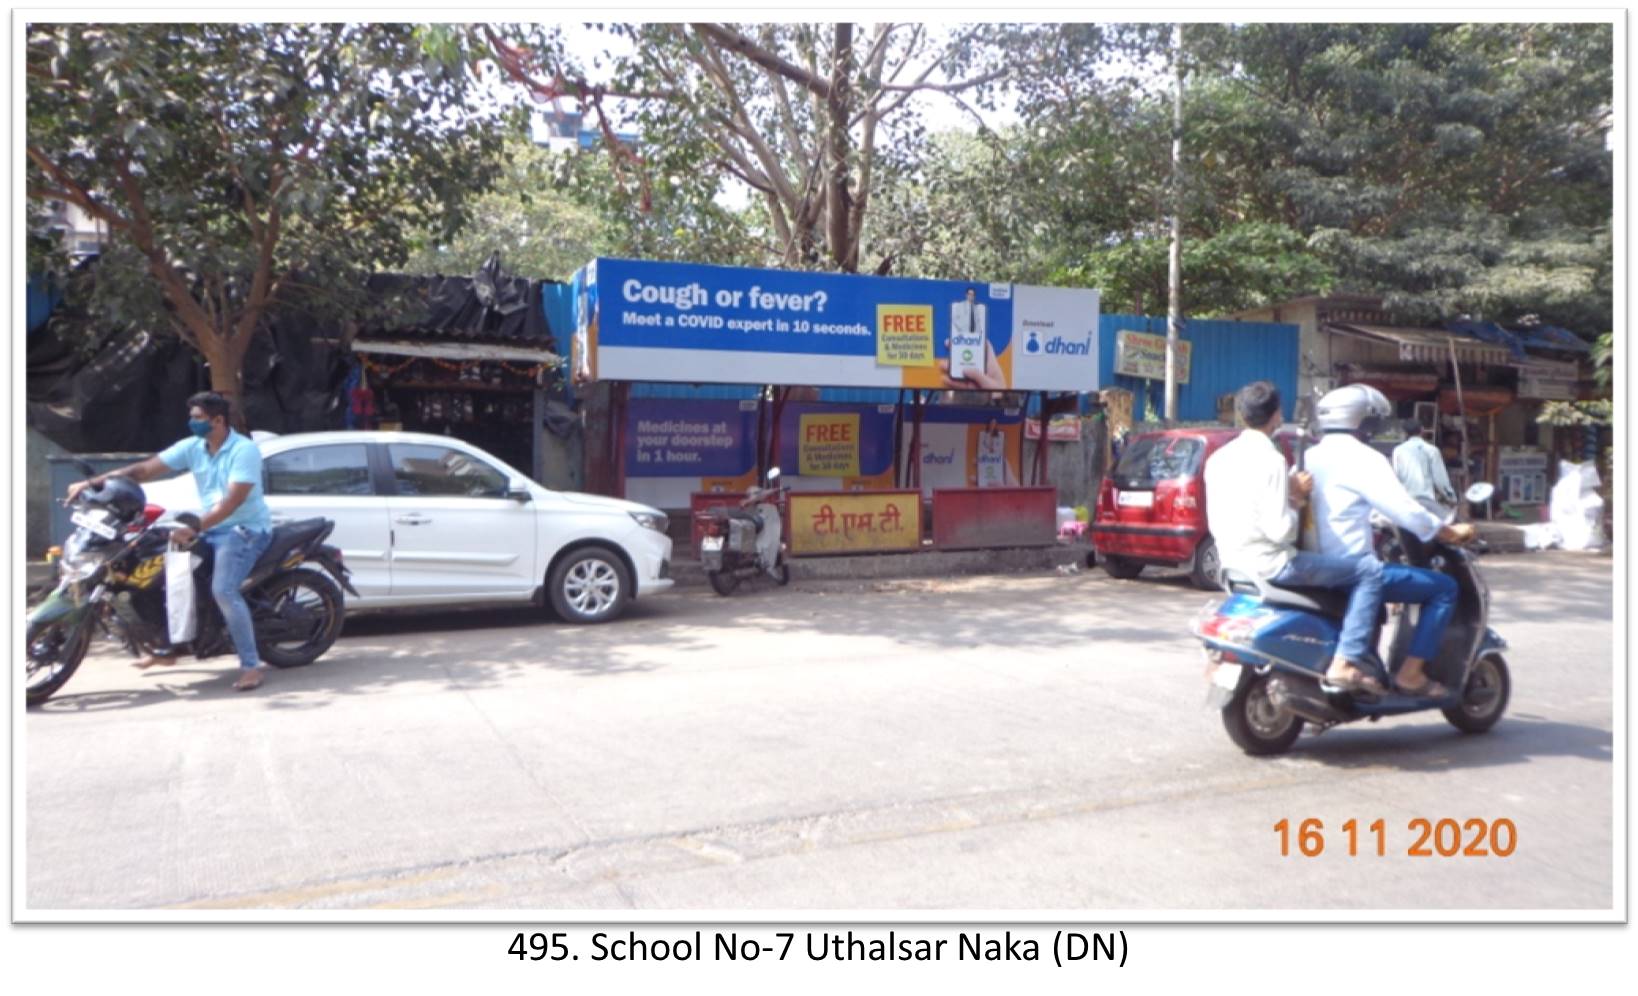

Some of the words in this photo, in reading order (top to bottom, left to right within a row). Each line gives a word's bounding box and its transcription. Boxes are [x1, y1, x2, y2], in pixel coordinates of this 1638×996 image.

[622, 279, 709, 310] Cough
[715, 289, 743, 307] or
[750, 286, 828, 312] fever?
[623, 312, 661, 327] Meet
[665, 316, 675, 327] a
[678, 314, 724, 329] COVID
[727, 318, 773, 333] expert
[776, 319, 789, 332] in
[793, 320, 809, 333] 10
[813, 321, 872, 336] seconds.
[883, 314, 926, 333] FREE
[952, 331, 983, 347] dhani
[1044, 331, 1092, 356] dhani
[637, 420, 709, 433] Medicines
[713, 421, 727, 433] at
[806, 423, 852, 442] FREE
[637, 436, 668, 448] your
[671, 434, 733, 448] doorstep
[637, 450, 650, 462] in
[654, 450, 662, 462] 1
[666, 450, 702, 462] hour.
[811, 503, 905, 541] टी.एम.टी.
